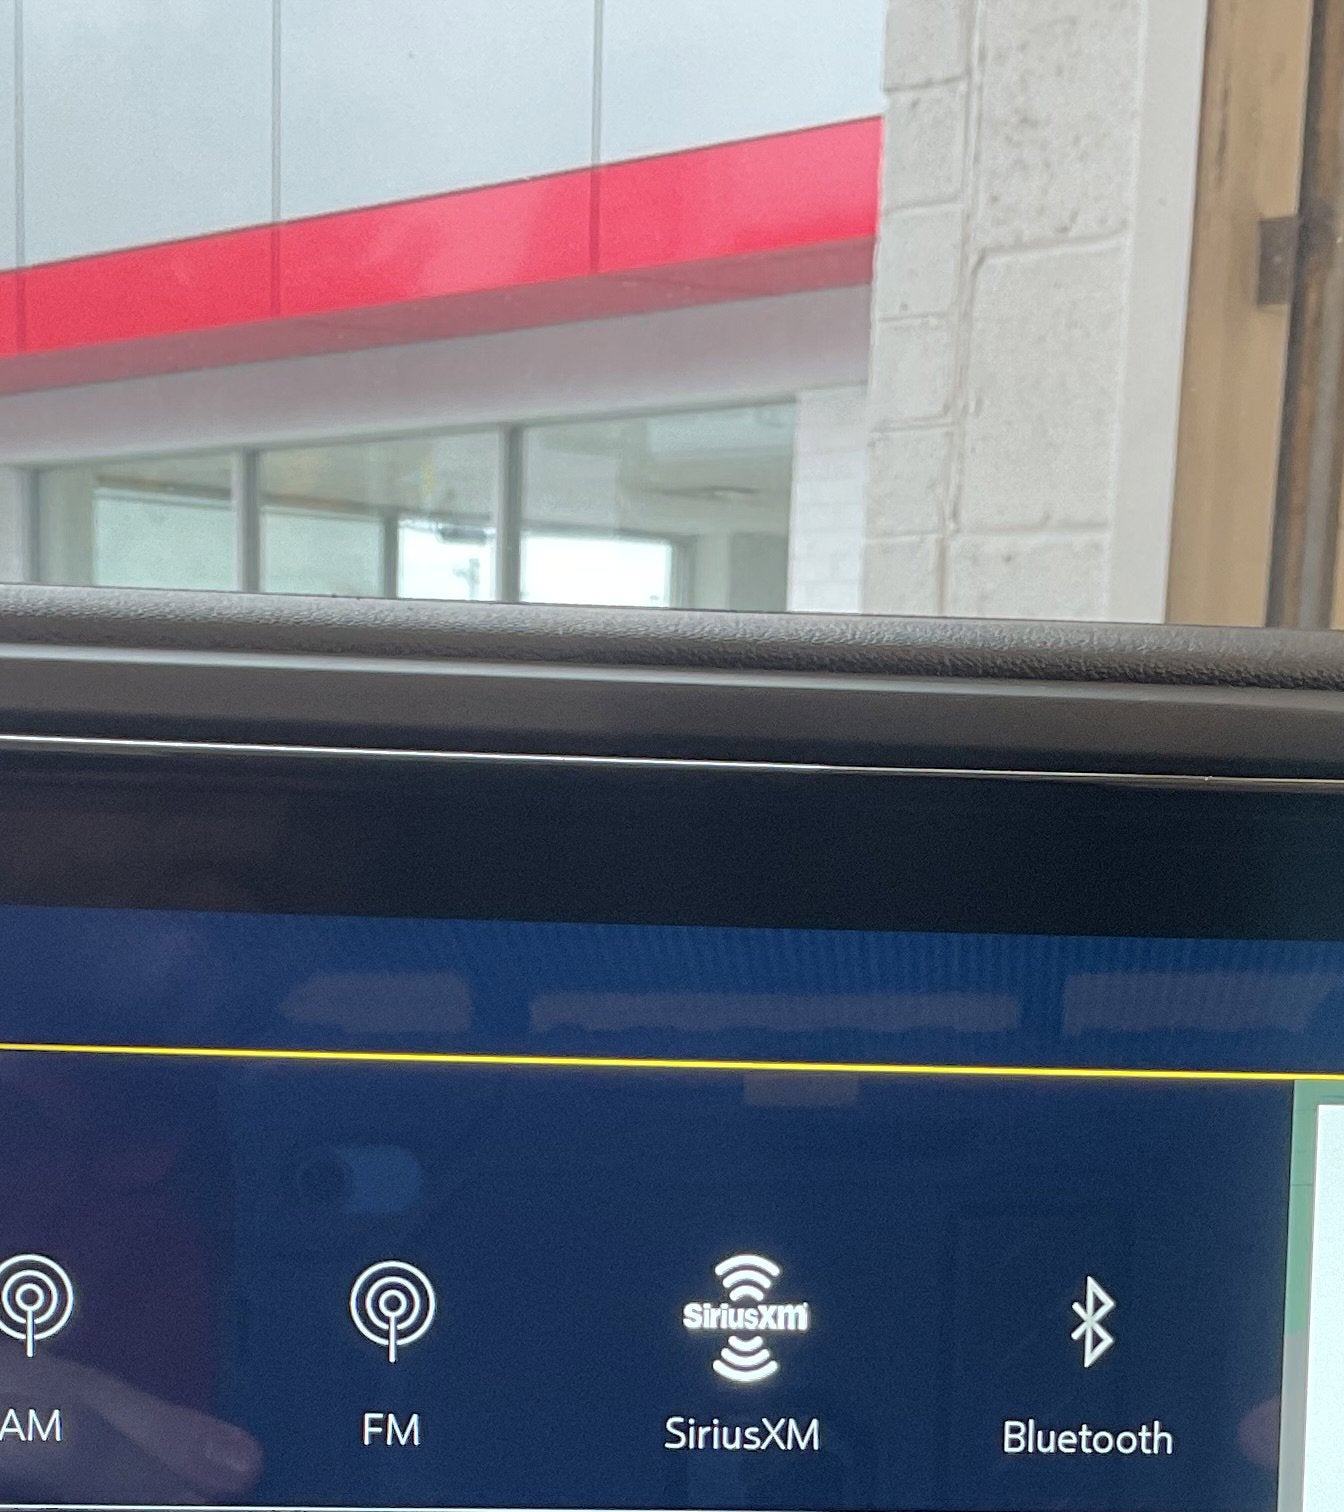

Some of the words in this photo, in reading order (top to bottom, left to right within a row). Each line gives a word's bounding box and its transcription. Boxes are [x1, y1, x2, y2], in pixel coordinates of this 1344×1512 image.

[364, 1413, 420, 1445] FM
[665, 1417, 818, 1450] SiriusXM
[1004, 1419, 1172, 1454] Bluetooth
